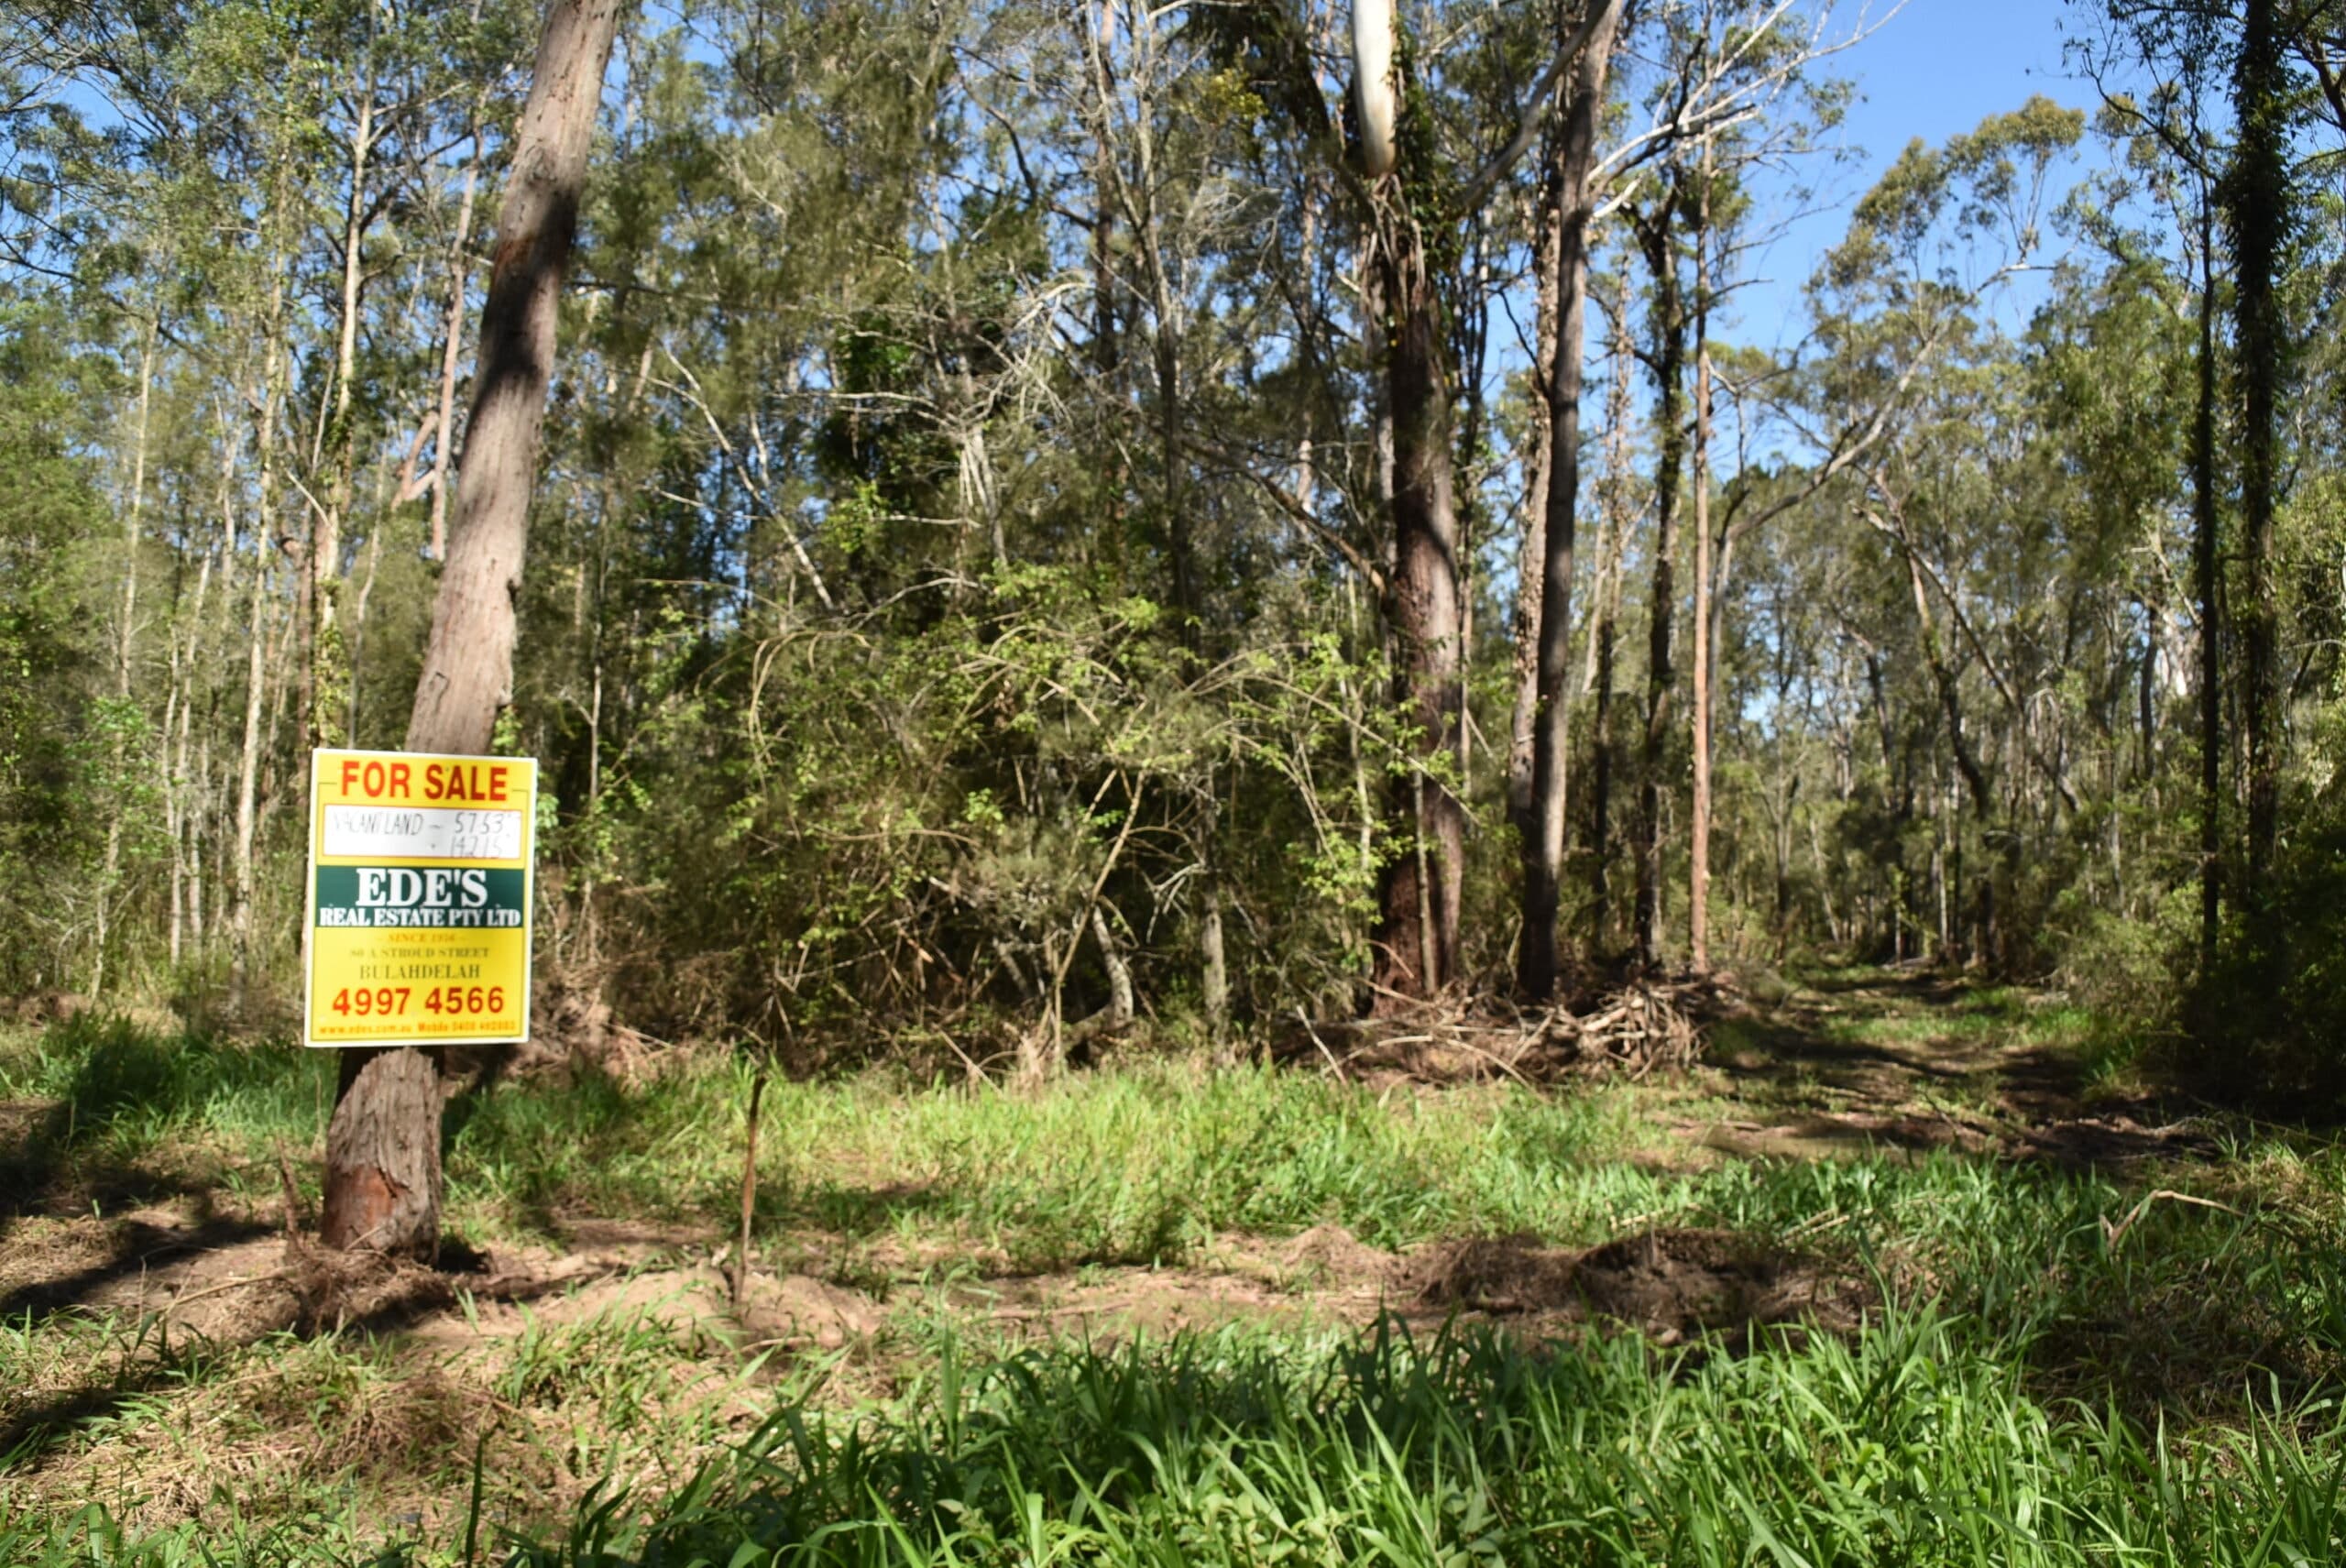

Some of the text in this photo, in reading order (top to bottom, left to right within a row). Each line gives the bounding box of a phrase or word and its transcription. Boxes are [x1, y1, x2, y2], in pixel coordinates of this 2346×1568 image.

[341, 761, 507, 802] FOR SALE
[384, 812, 424, 836] LAND
[355, 868, 488, 907] EDE'S
[320, 908, 521, 927] REAL ESTATE PTY LTD
[388, 933, 426, 943] SINCE
[381, 948, 435, 959] STROUD
[439, 948, 489, 959] STREET
[359, 964, 481, 980] BULAHDELAH
[332, 986, 505, 1016] 4997 4566
